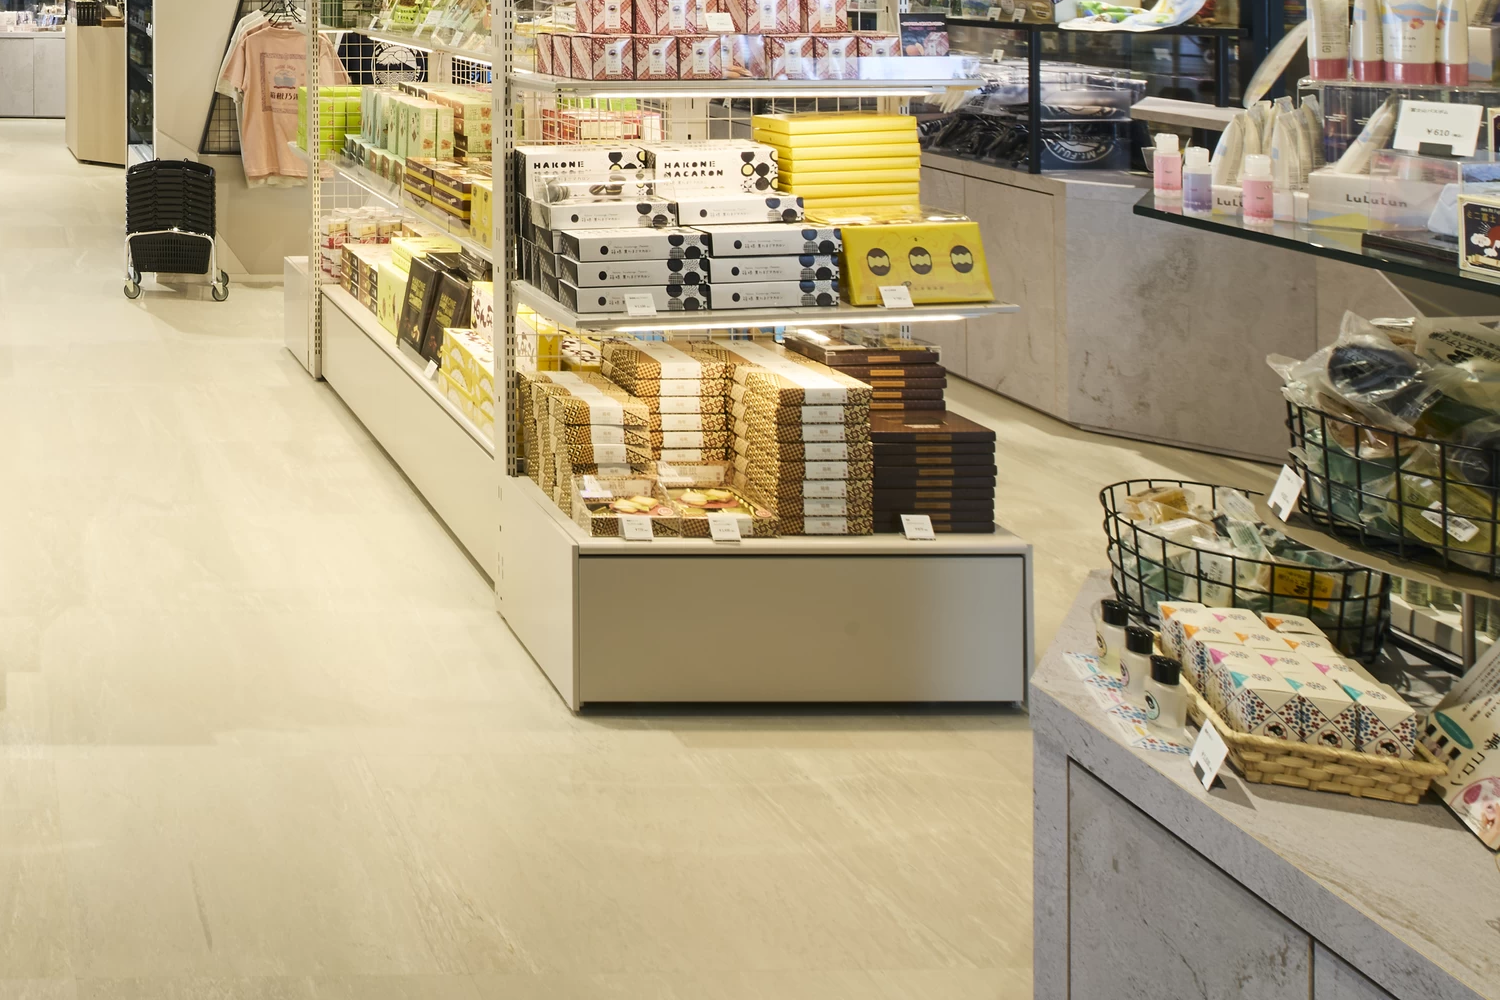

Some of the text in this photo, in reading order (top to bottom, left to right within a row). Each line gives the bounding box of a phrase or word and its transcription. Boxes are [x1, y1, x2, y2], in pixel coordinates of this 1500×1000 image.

[1426, 128, 1450, 136] ¥610
[534, 160, 585, 170] HAKONE
[664, 160, 716, 169] HAKONE
[664, 170, 724, 178] MACARON
[1346, 193, 1408, 208] LuLuLun
